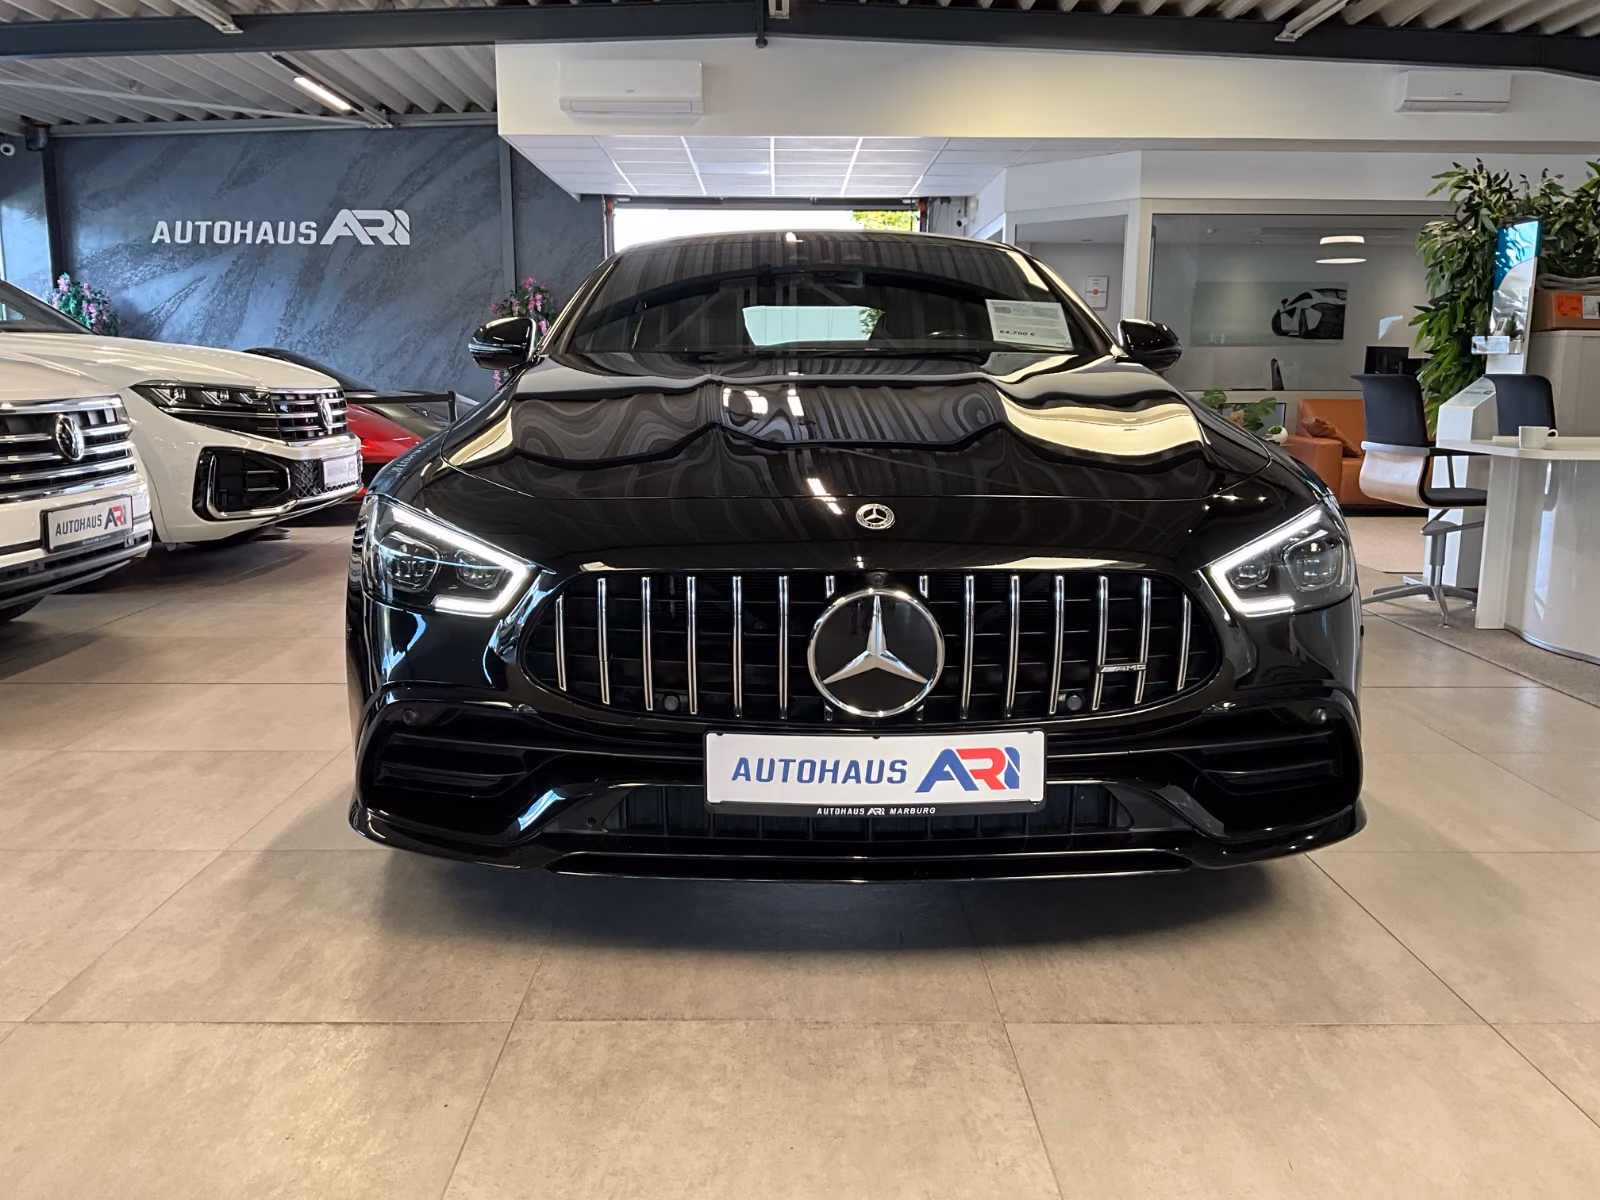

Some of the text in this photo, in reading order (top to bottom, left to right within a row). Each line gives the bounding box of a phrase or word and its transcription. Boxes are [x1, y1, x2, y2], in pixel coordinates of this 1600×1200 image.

[151, 220, 317, 245] AUTOHAUS
[55, 514, 102, 536] AUTOHAUS
[731, 757, 908, 785] AUTOHAUS
[816, 807, 865, 816] AUTOHAUS
[889, 807, 936, 815] MARBURG
